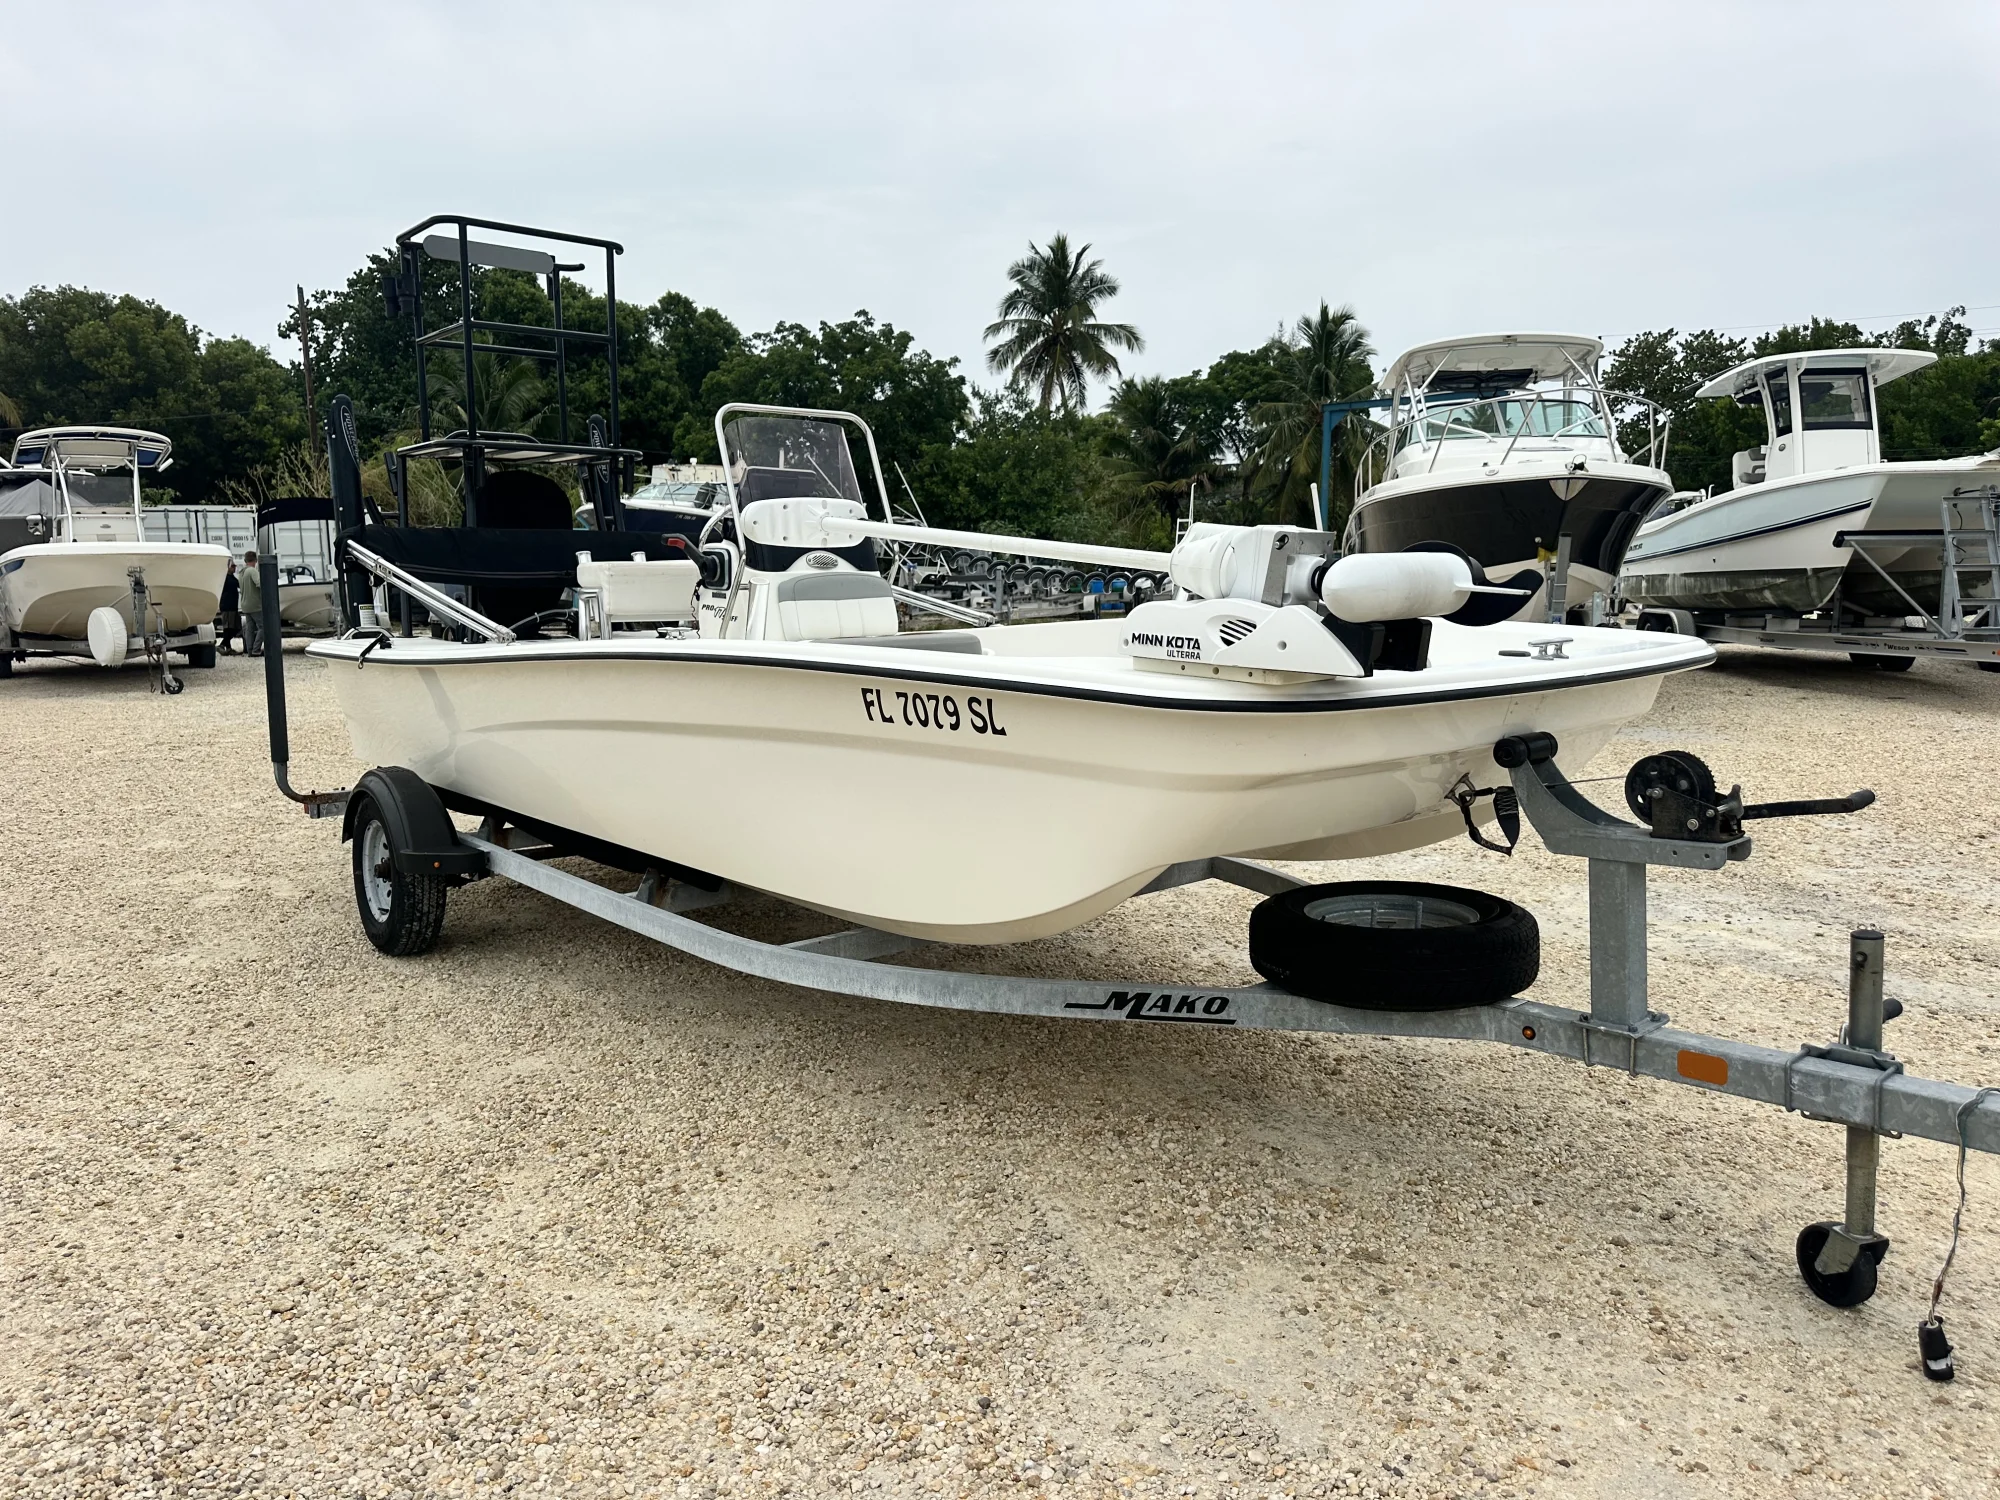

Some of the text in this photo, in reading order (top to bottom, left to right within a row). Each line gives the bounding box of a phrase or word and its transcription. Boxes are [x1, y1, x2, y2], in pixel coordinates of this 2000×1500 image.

[1131, 632, 1201, 651] MINN KOTA
[1166, 649, 1201, 661] ULTERRA
[861, 687, 1007, 737] FL 7079 SL
[1094, 991, 1231, 1020] MAKO
